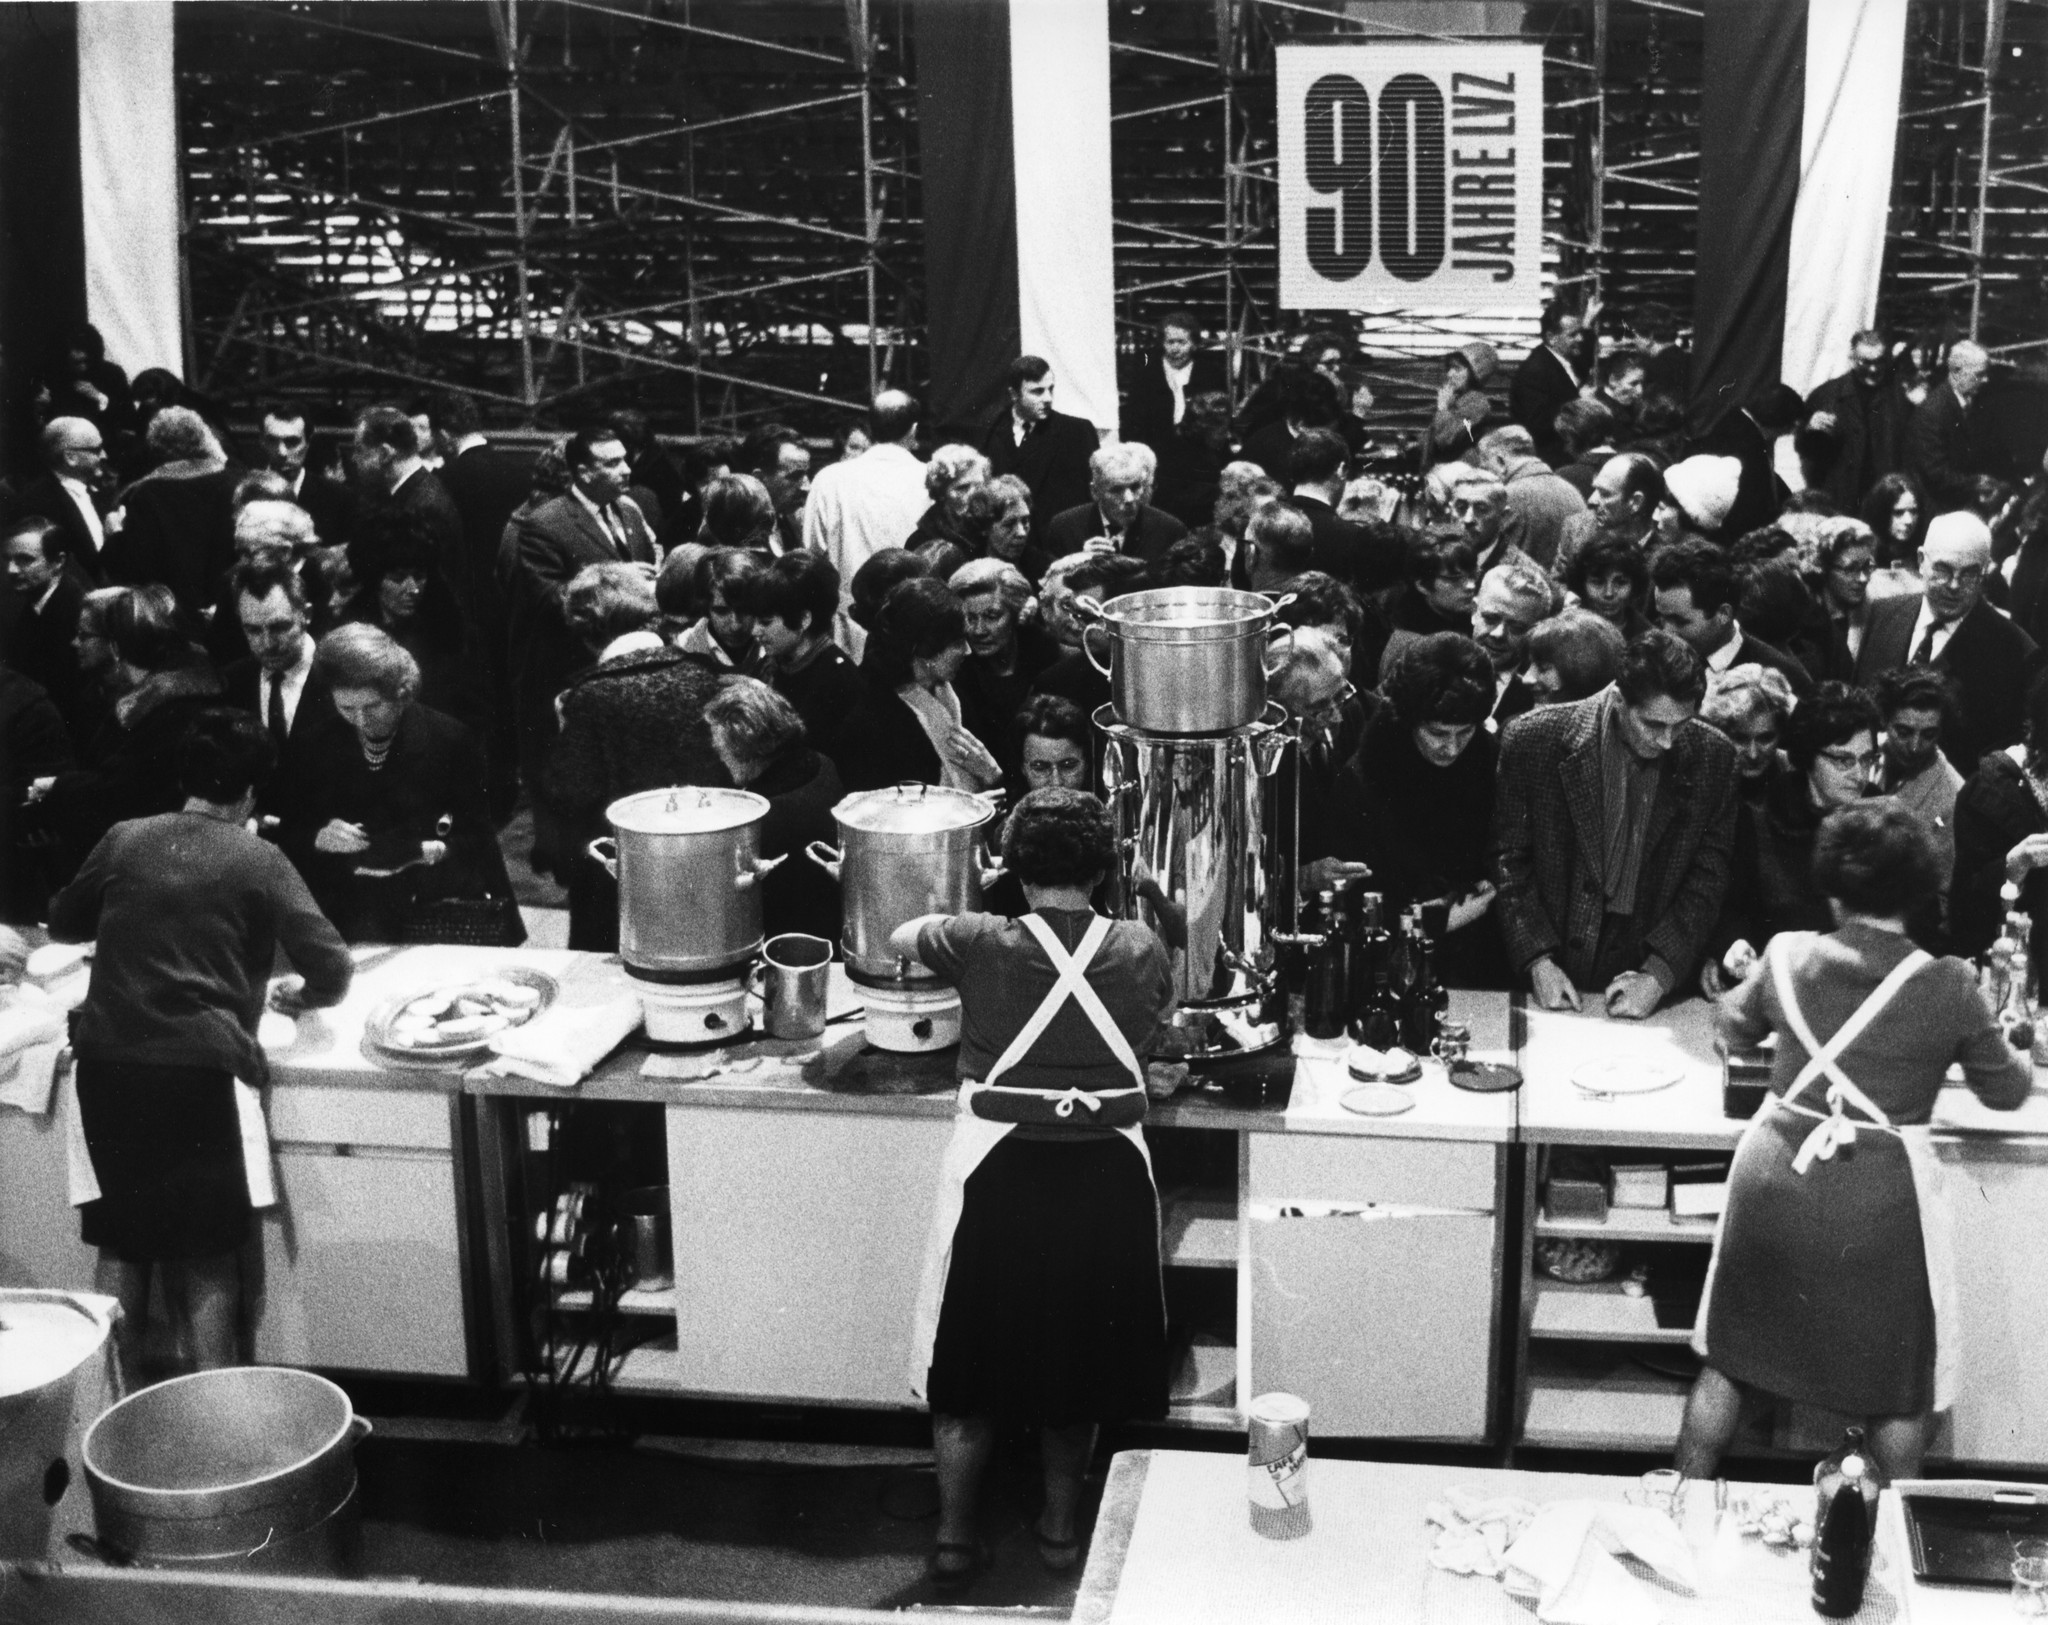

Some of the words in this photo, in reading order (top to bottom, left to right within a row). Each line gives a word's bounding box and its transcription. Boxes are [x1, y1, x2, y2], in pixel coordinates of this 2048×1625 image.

[1451, 72, 1516, 136] LVZ
[1304, 73, 1446, 282] 90
[1451, 147, 1516, 283] JAHRE
